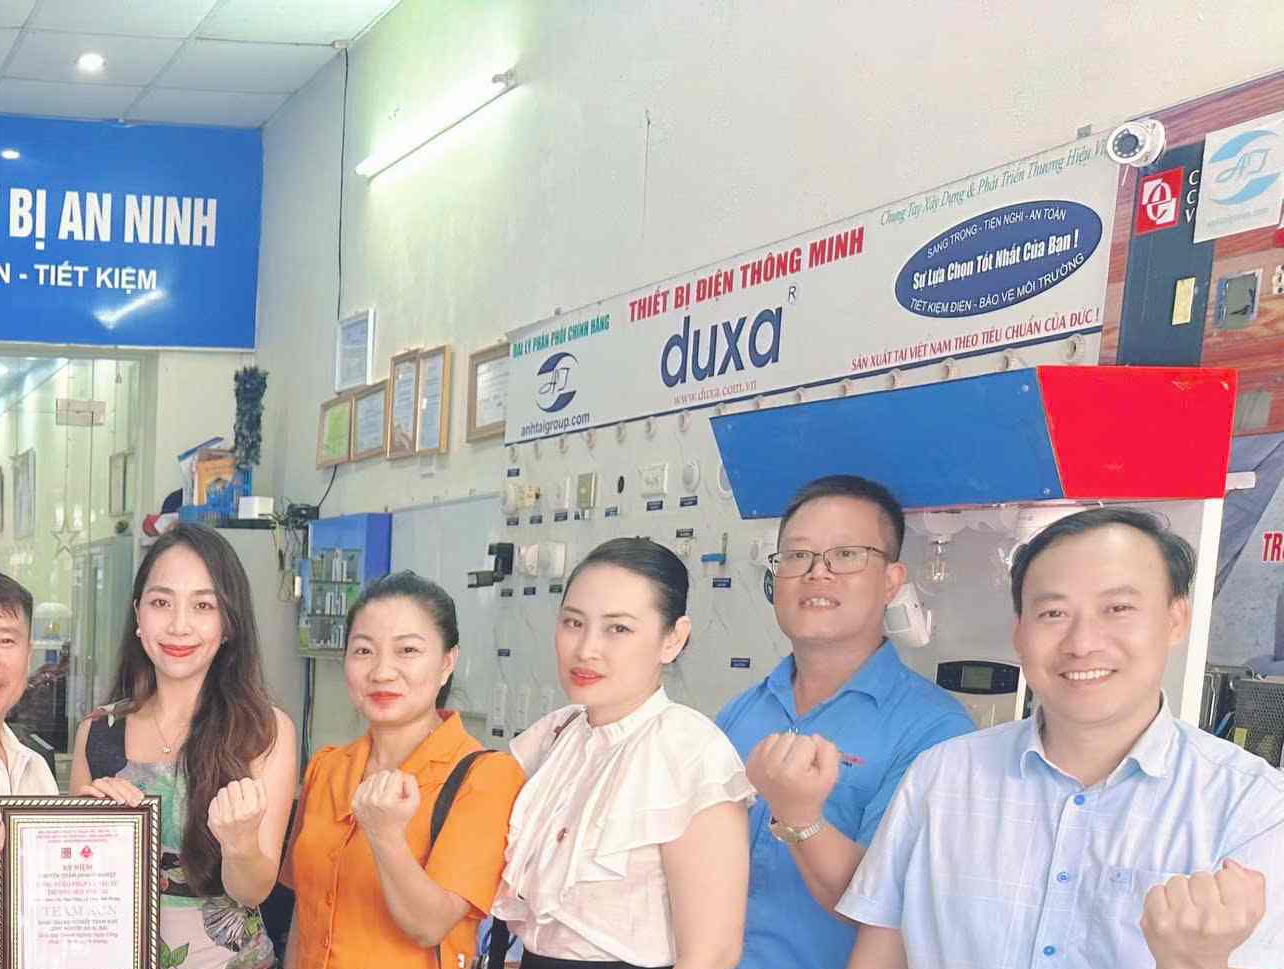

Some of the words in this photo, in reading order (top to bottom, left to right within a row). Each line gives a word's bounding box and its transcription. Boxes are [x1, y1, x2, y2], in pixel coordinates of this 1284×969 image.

[10, 187, 47, 250] BỊ
[58, 190, 112, 242] AN
[124, 194, 217, 247] NINH
[926, 236, 949, 258] SANG
[1048, 233, 1072, 258] Bạn
[96, 266, 157, 294] KIỆM
[674, 283, 691, 311] BỊ
[740, 247, 802, 289] THÔNG
[808, 226, 865, 269] MINH
[661, 305, 783, 388] duxa
[954, 333, 979, 350] THEO
[520, 412, 591, 437] anhtaigroup.com
